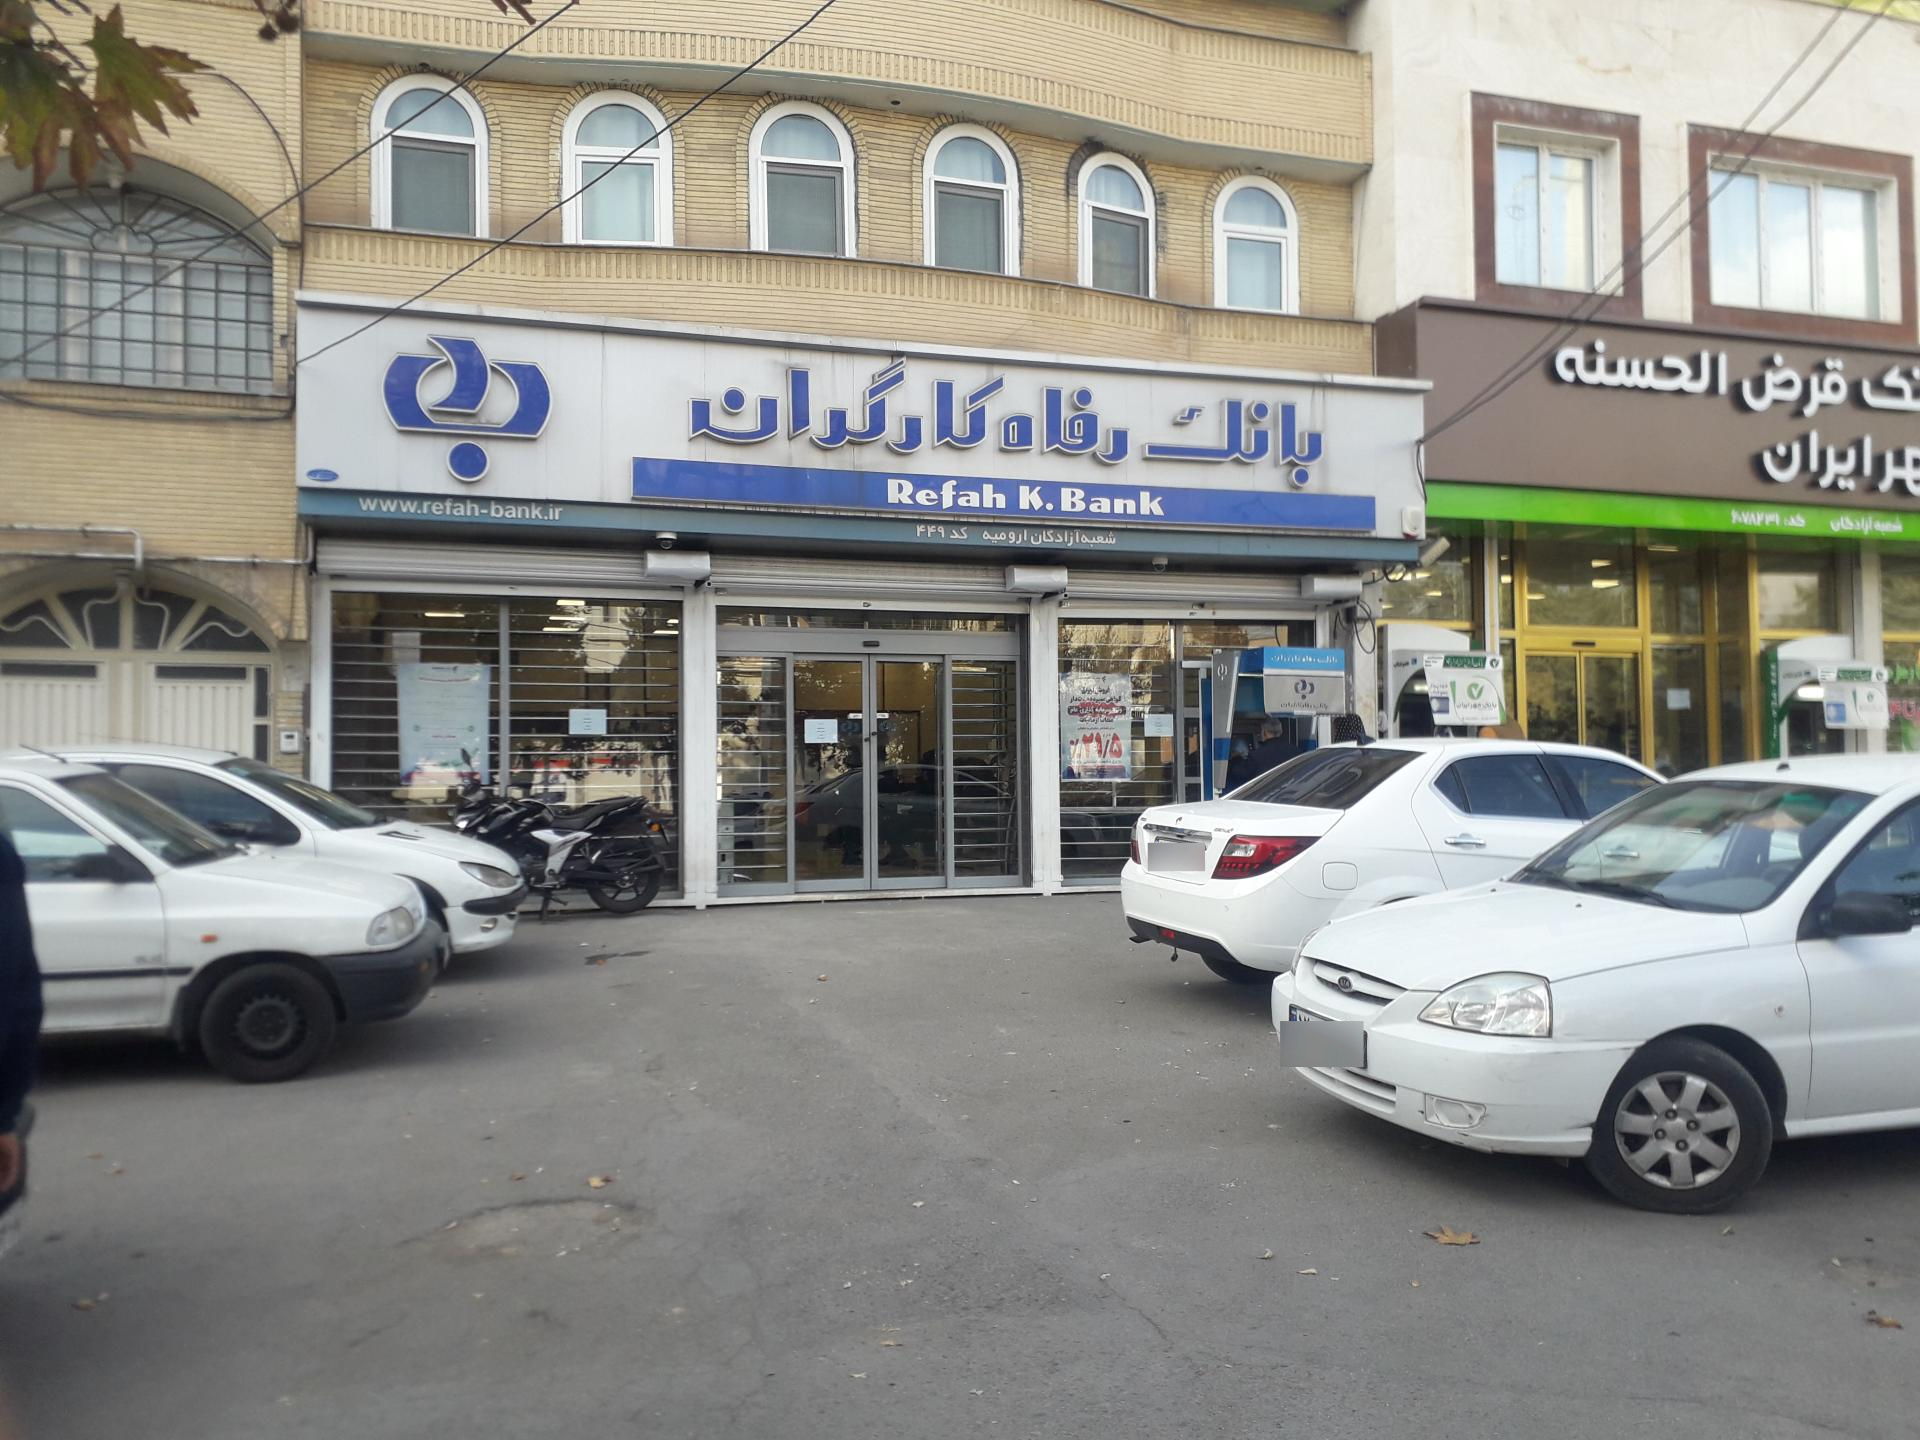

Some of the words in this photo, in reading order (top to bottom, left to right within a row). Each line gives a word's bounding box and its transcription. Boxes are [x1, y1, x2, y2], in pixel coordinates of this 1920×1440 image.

[1555, 338, 1729, 396] الحسنه
[1741, 353, 1848, 418] قرض
[687, 355, 1006, 455] کارگران
[1000, 385, 1131, 466] رفاه
[1141, 397, 1325, 490] بانک
[1762, 429, 1873, 493] ایران
[358, 495, 564, 522] www.refah-bank.ir
[886, 478, 1007, 511] Refah
[916, 525, 945, 538] ۴۴۹
[949, 527, 968, 540] کد
[982, 529, 1028, 545] ارومیه
